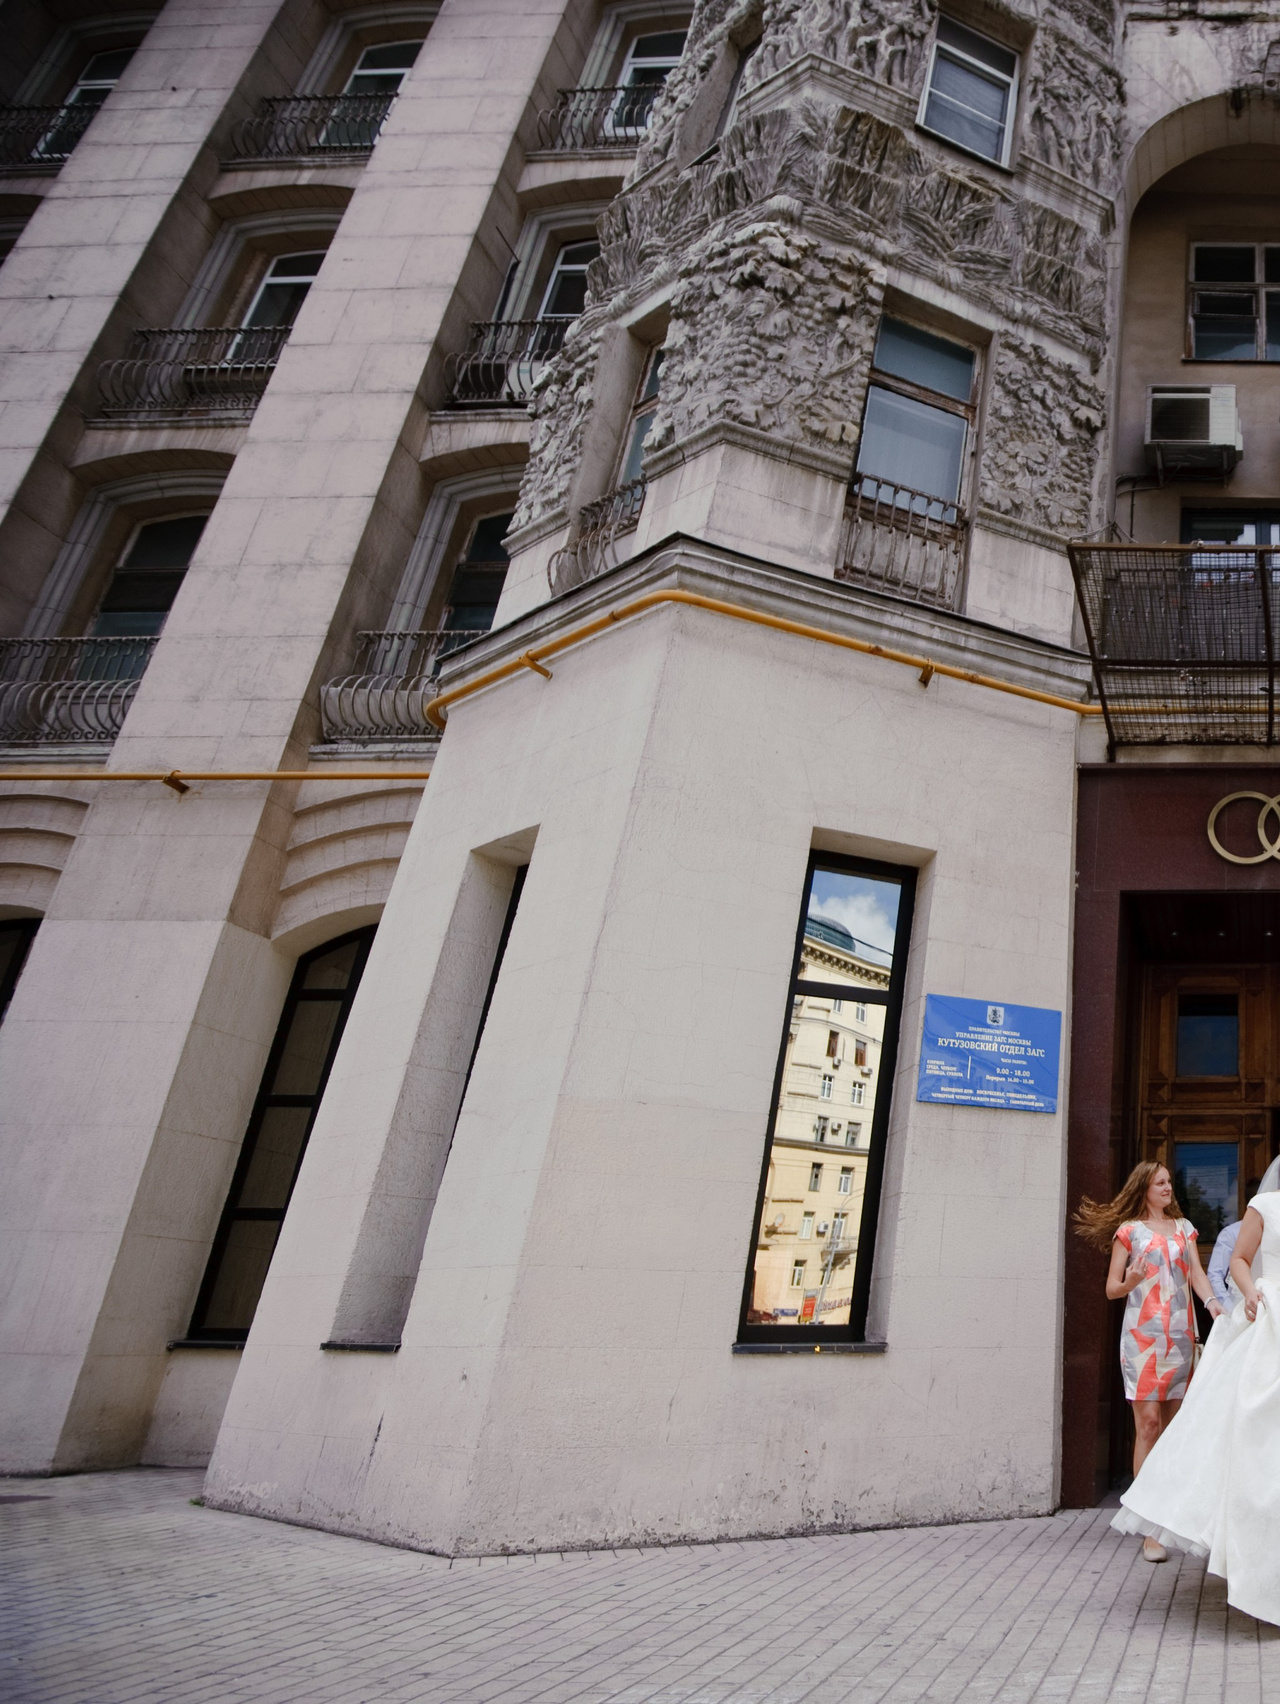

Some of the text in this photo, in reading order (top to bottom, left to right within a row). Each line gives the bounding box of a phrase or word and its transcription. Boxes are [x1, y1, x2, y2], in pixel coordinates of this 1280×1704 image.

[955, 1031, 993, 1041] УПРАВЛЕНИЕ
[1008, 1037, 1031, 1046] МОСКВЫ
[938, 1037, 1045, 1057] КУТУЗОВСКИЙ ОТДЕЛ ЗАГС
[996, 1067, 1009, 1075] 9.00
[1014, 1069, 1030, 1077] 18.00
